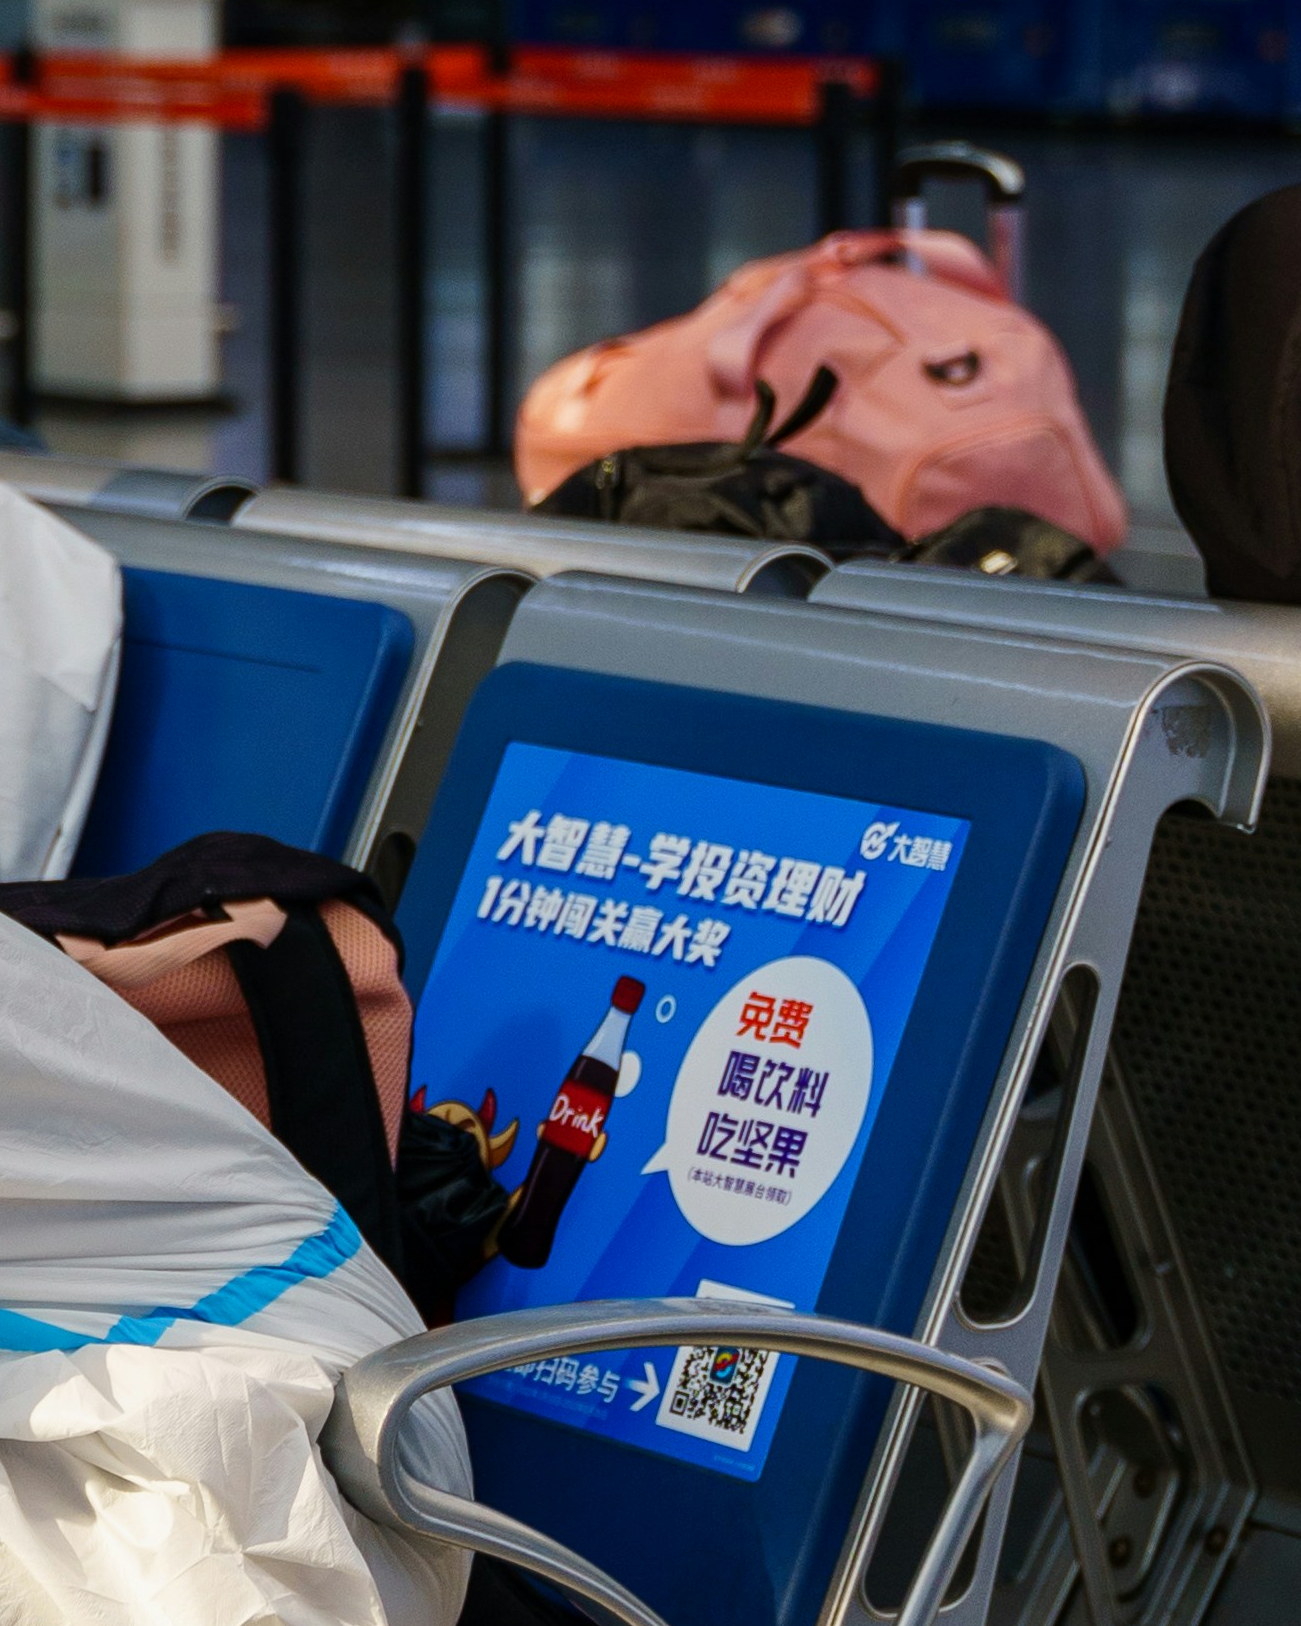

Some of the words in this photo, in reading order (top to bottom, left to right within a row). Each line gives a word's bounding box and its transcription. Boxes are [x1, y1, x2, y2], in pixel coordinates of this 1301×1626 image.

[497, 809, 867, 928] 大智慧-学投资理财
[887, 832, 953, 872] 大智慧
[477, 875, 731, 968] 1分钟闯关赢大奖
[735, 990, 814, 1050] 免费
[549, 1094, 604, 1137] Drink
[717, 1050, 830, 1119] 喝饮料
[697, 1111, 808, 1179] 吃坚果
